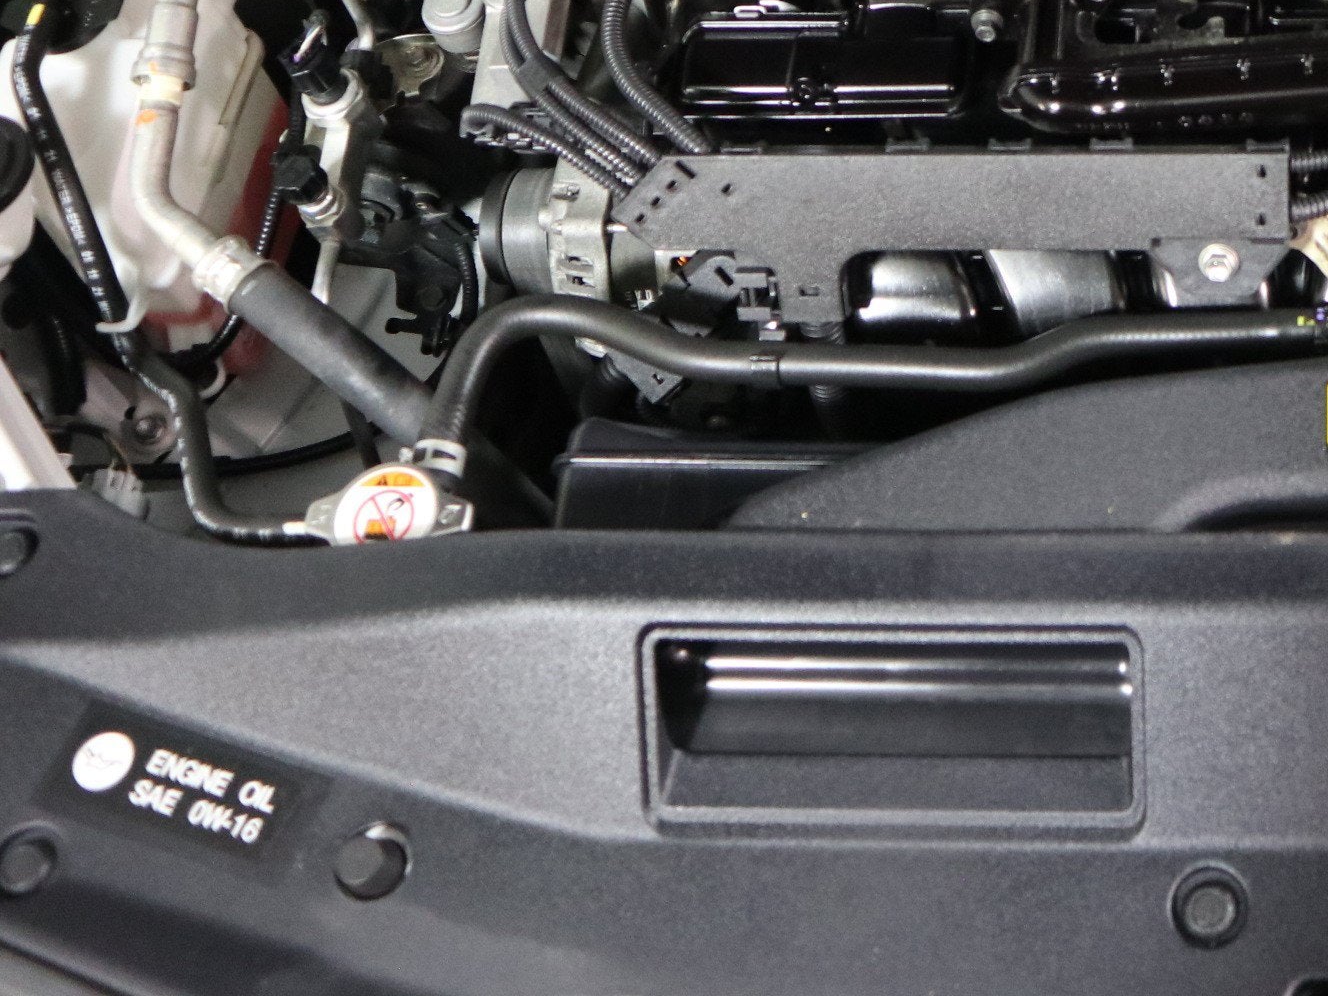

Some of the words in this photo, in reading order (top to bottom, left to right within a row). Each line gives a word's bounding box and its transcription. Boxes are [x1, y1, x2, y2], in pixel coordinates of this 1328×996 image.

[128, 779, 184, 818] SAE
[187, 799, 264, 844] 0W-16
[145, 748, 235, 798] ENGINE
[238, 779, 276, 815] OIL
